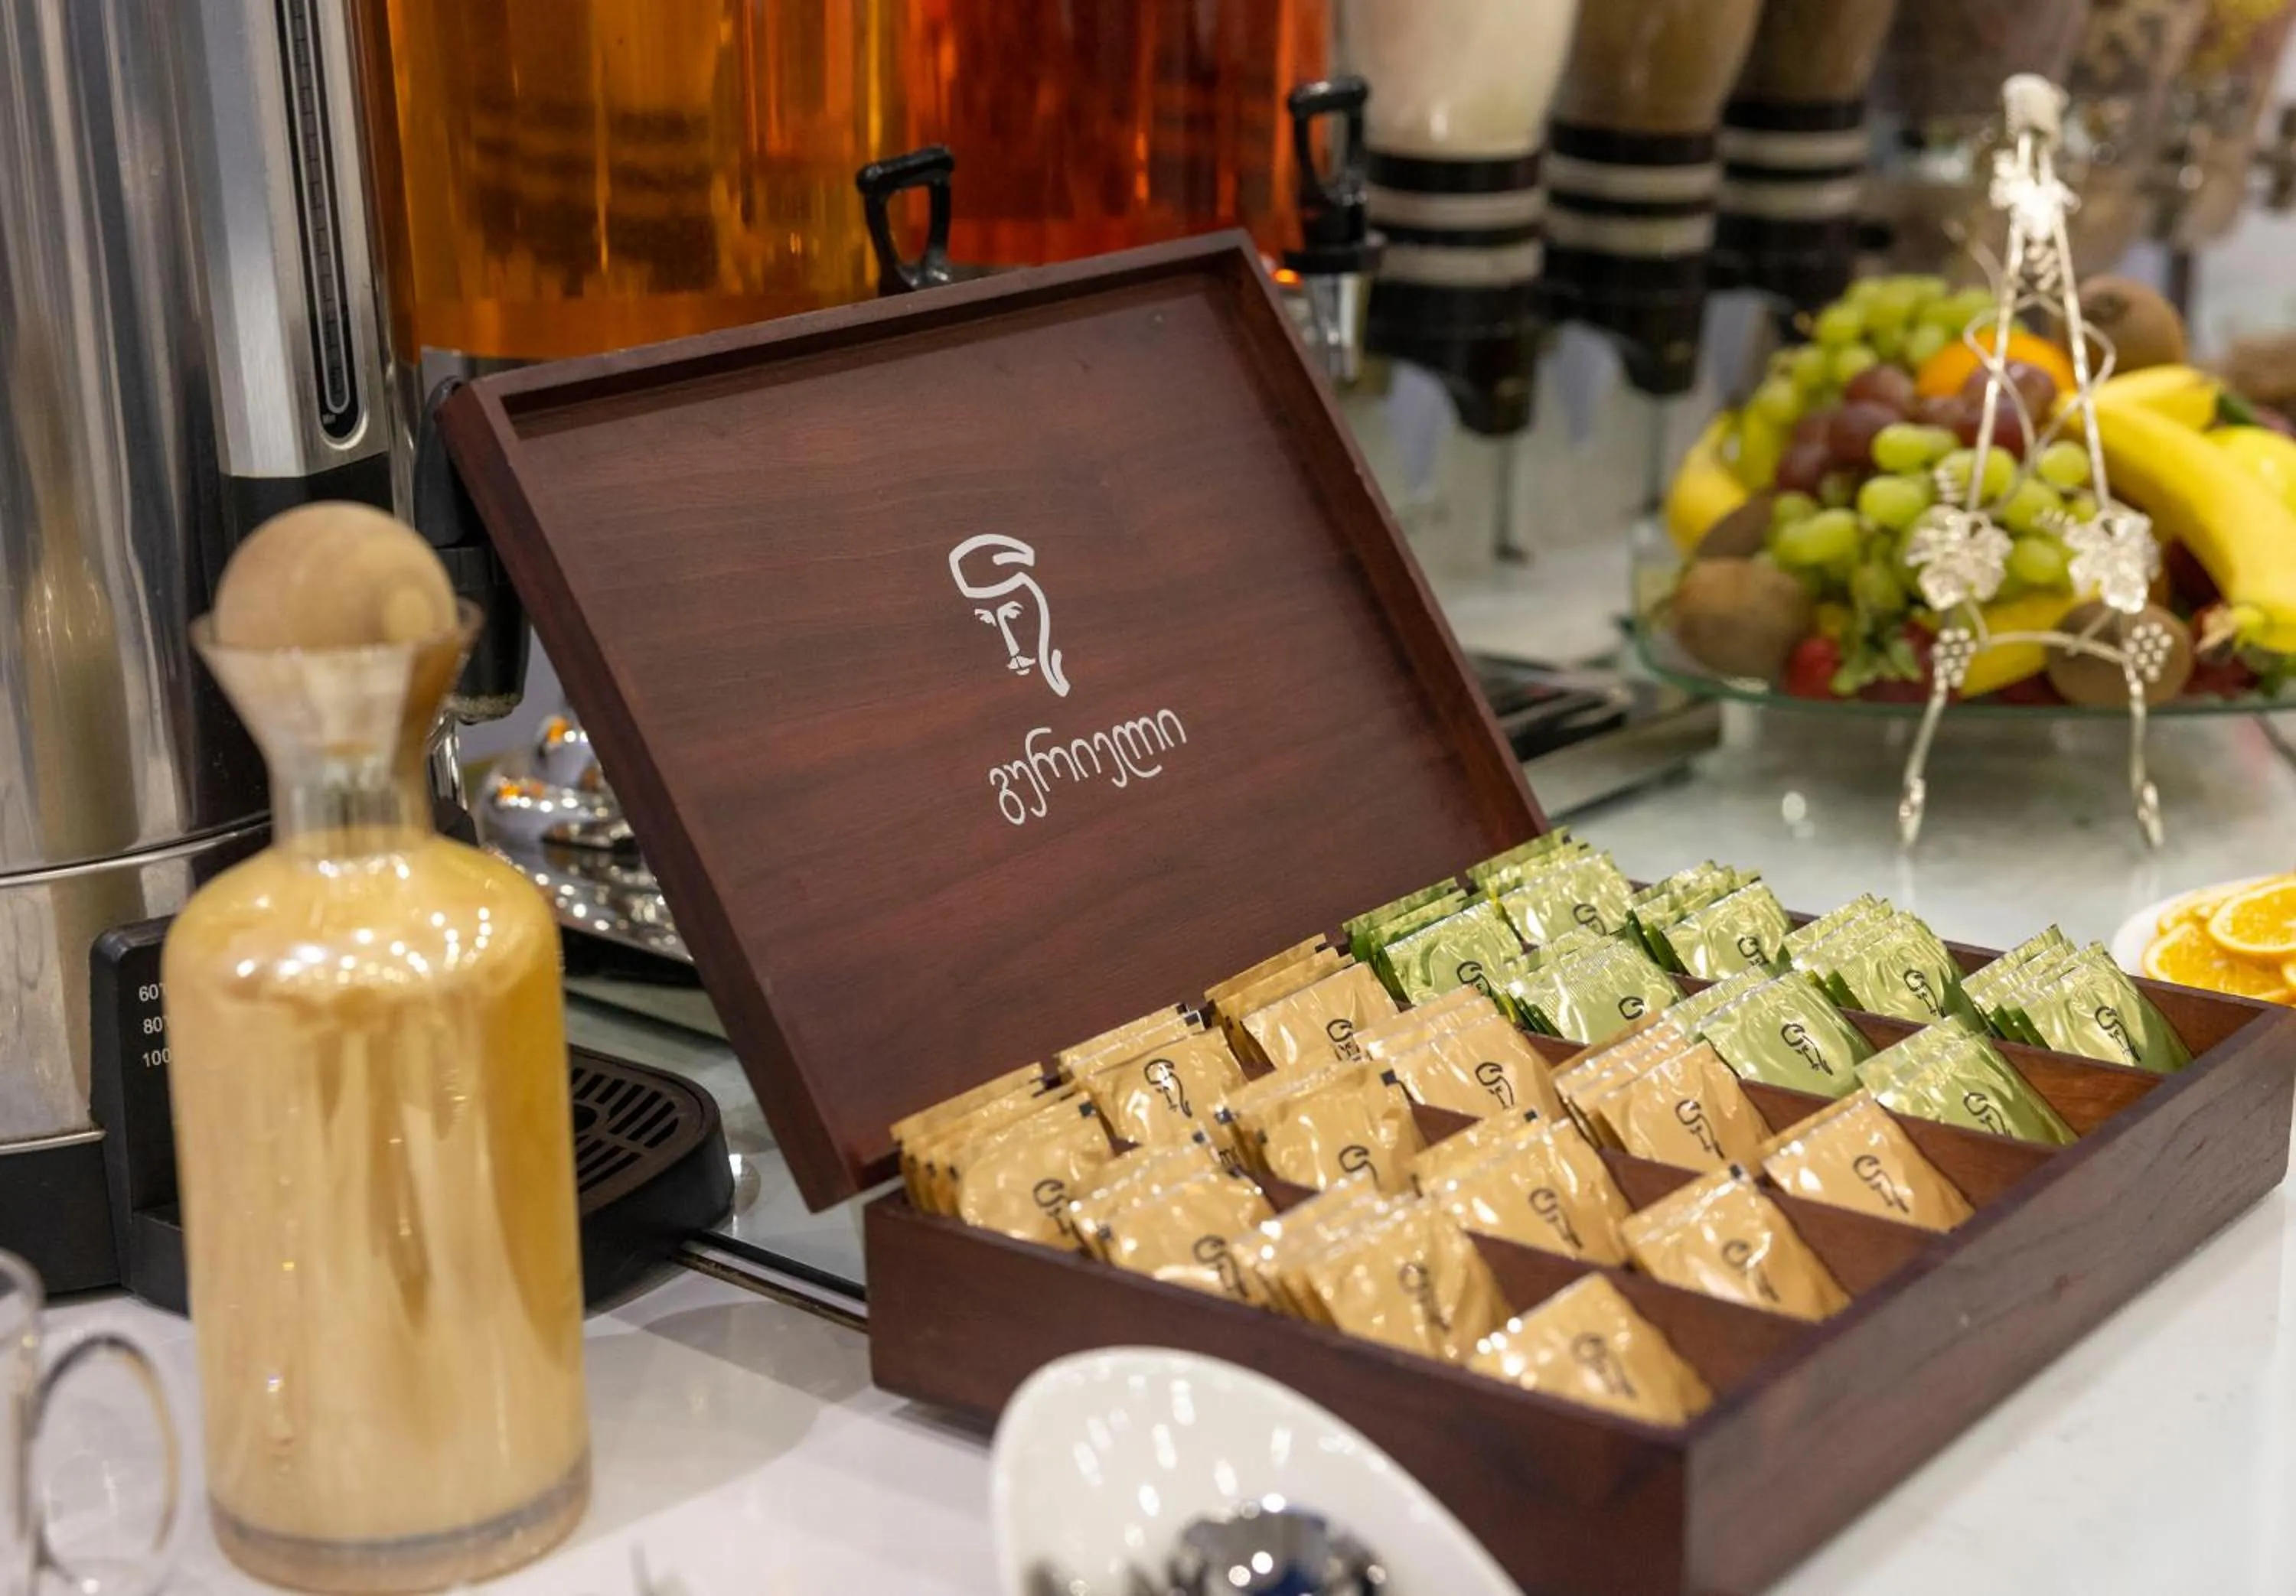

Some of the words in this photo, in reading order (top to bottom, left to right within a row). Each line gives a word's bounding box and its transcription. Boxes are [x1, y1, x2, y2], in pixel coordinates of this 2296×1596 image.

[990, 709, 1188, 826] გურიელი
[143, 1015, 168, 1034] 80
[142, 1048, 171, 1067] 100
